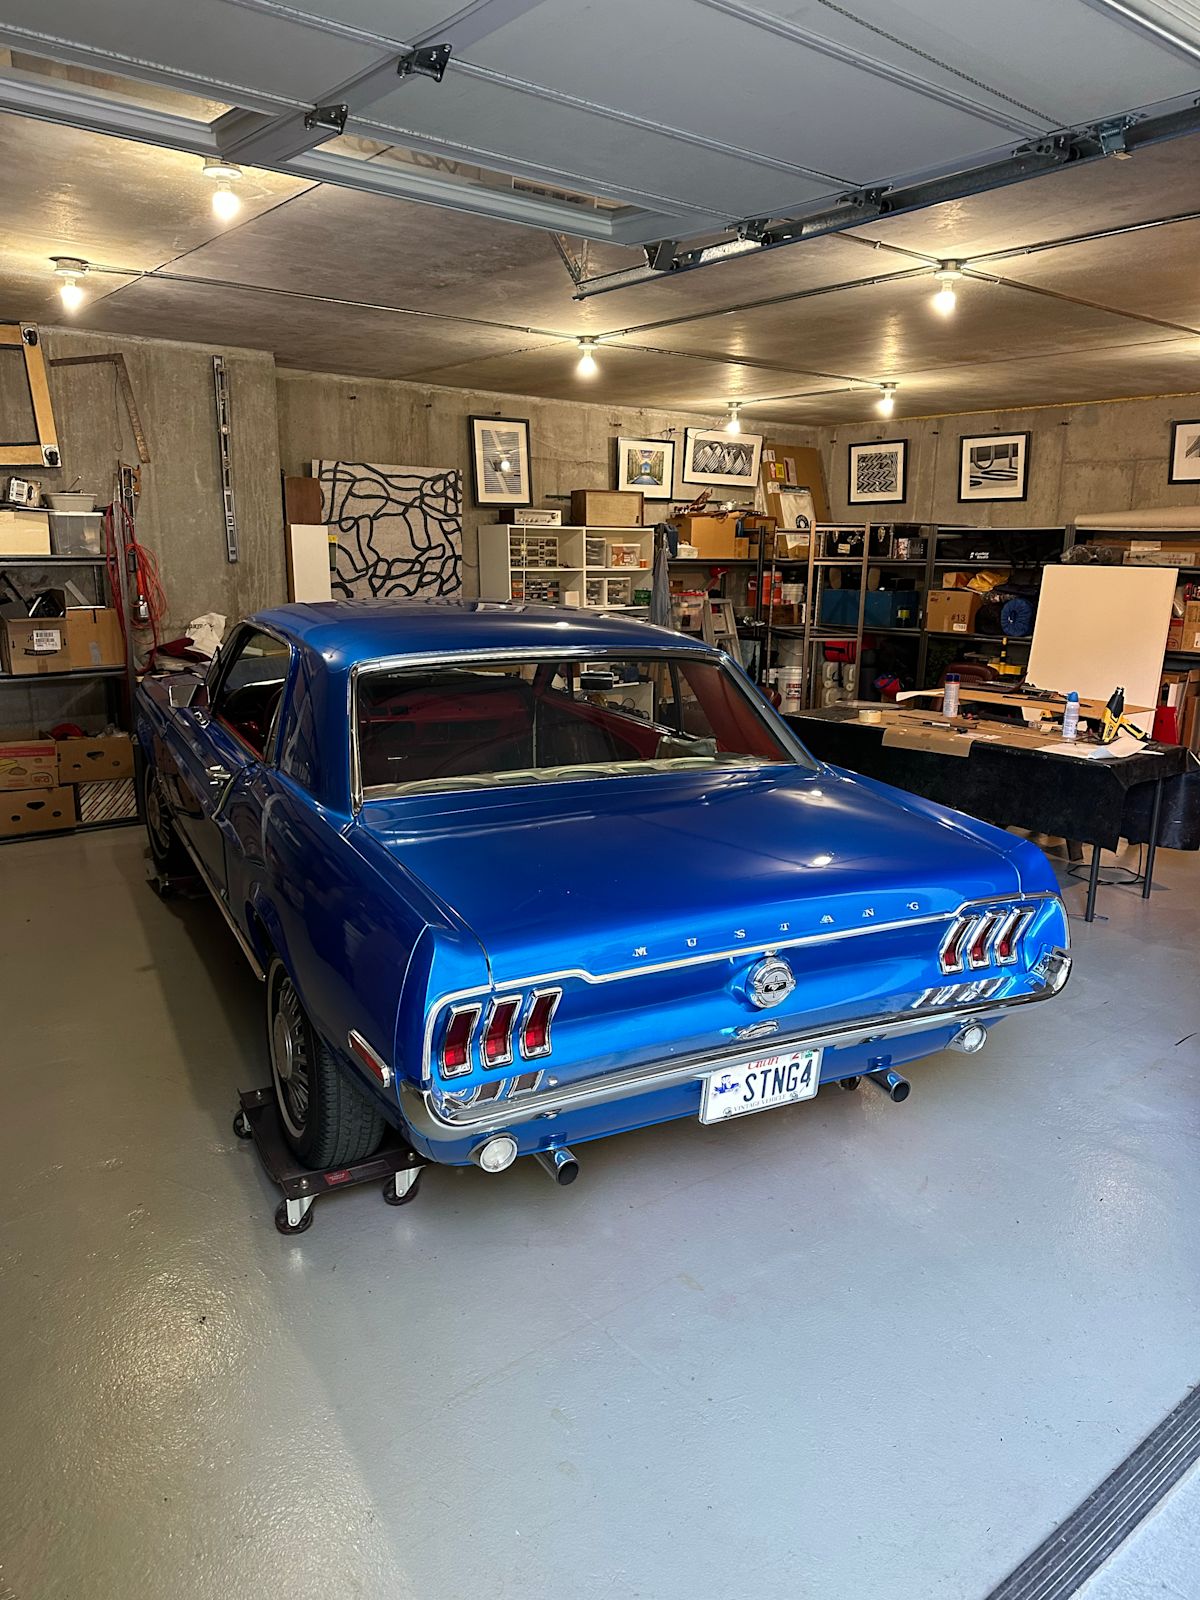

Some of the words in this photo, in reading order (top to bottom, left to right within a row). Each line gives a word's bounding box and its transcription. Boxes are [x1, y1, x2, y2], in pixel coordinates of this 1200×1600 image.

[633, 901, 920, 957] MUSTANG
[743, 1059, 813, 1102] STNG4
[733, 1101, 760, 1112] VINTAGE
